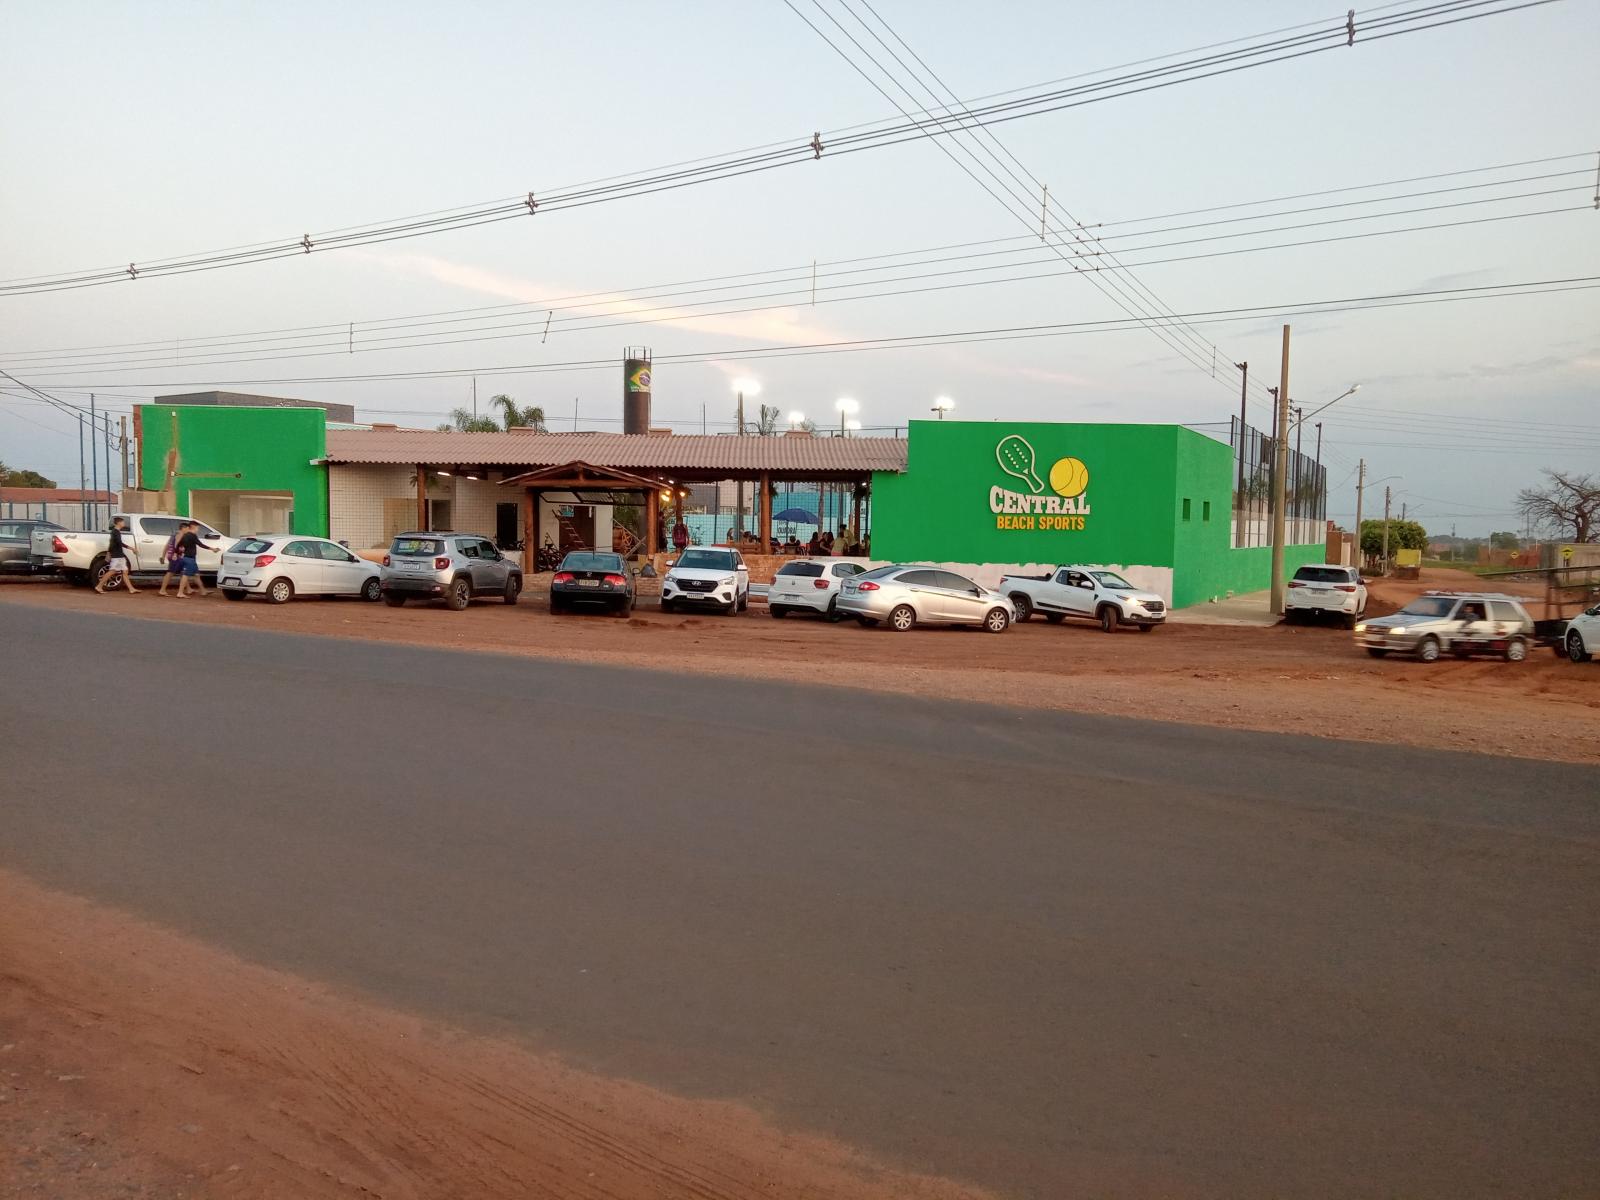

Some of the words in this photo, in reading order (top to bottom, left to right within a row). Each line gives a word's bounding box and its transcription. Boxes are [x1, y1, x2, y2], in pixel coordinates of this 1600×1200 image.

[990, 485, 1090, 514] CENTRAL
[997, 516, 1034, 530] BEACH
[1039, 516, 1084, 530] SPORTS
